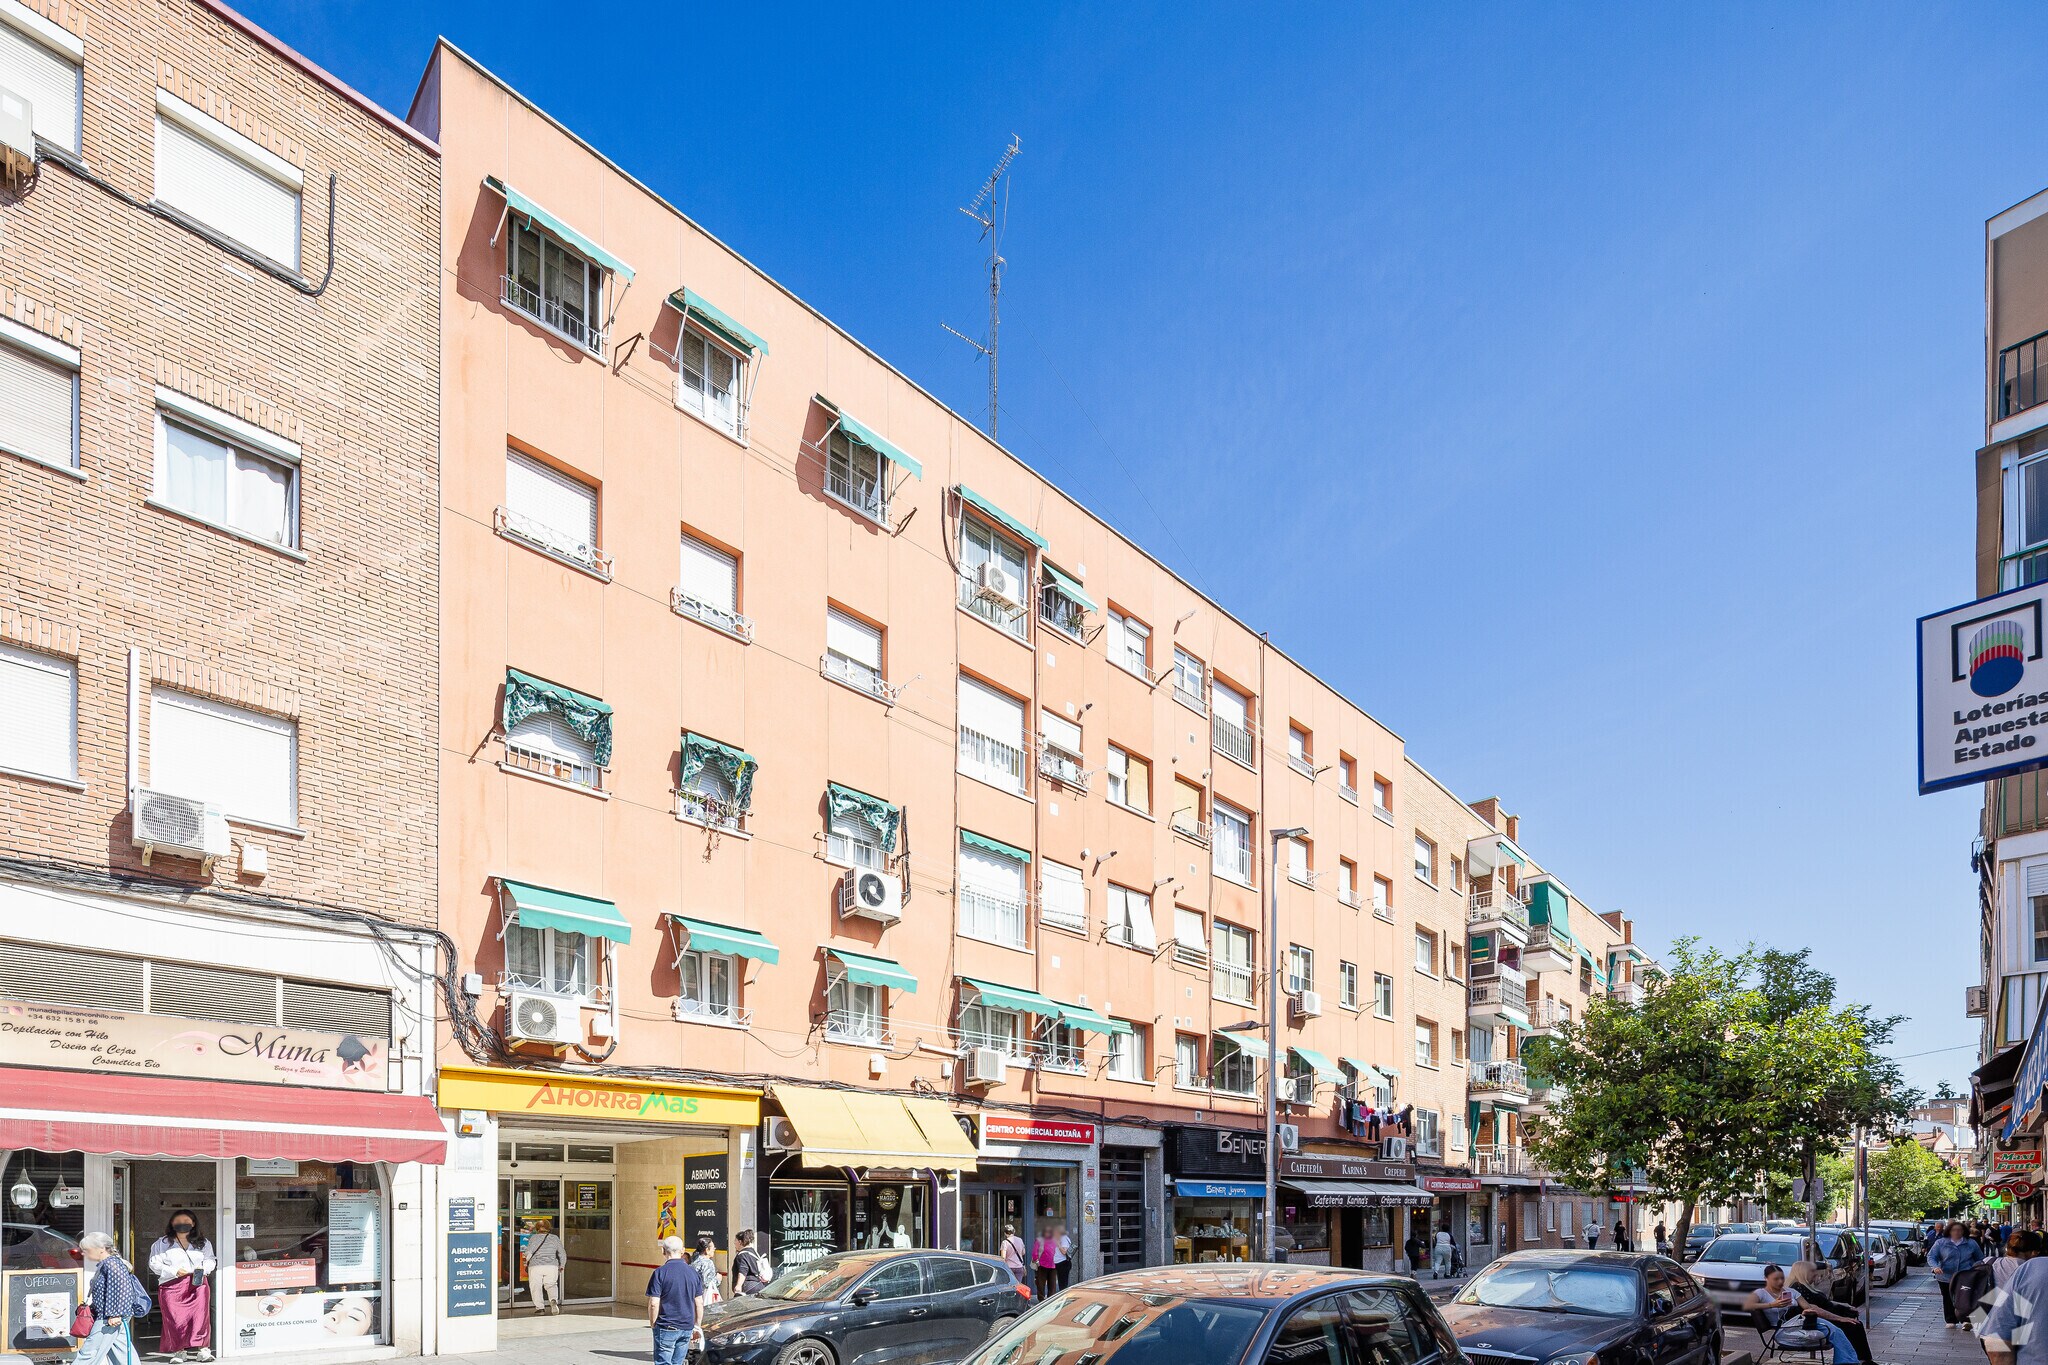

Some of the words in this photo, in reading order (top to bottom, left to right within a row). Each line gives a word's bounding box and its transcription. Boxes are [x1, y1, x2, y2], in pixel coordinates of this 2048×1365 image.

[1954, 711, 2048, 744] Apuesta
[1954, 734, 2036, 764] Estado
[28, 1007, 125, 1020] munadepilacionconhilo.com
[1, 1023, 61, 1036] Depilación
[84, 1030, 108, 1040] Hilo
[50, 1040, 86, 1051] Diseño
[107, 1045, 136, 1056] Cejas
[219, 1032, 330, 1063] Muna
[92, 1056, 141, 1067] Cosmética
[145, 1060, 160, 1068] Bio
[986, 1124, 1014, 1134] CENTRO
[1015, 1126, 1053, 1136] COMERCIAL
[1054, 1128, 1081, 1138] BOLTAÑA
[2001, 1152, 2035, 1160] Maxi
[1995, 1162, 2040, 1171] Fruta
[691, 1169, 720, 1180] ABRIMOS
[783, 1212, 829, 1228] CORTES
[784, 1230, 831, 1240] IMPECABLES
[25, 1276, 61, 1287] OFERTA
